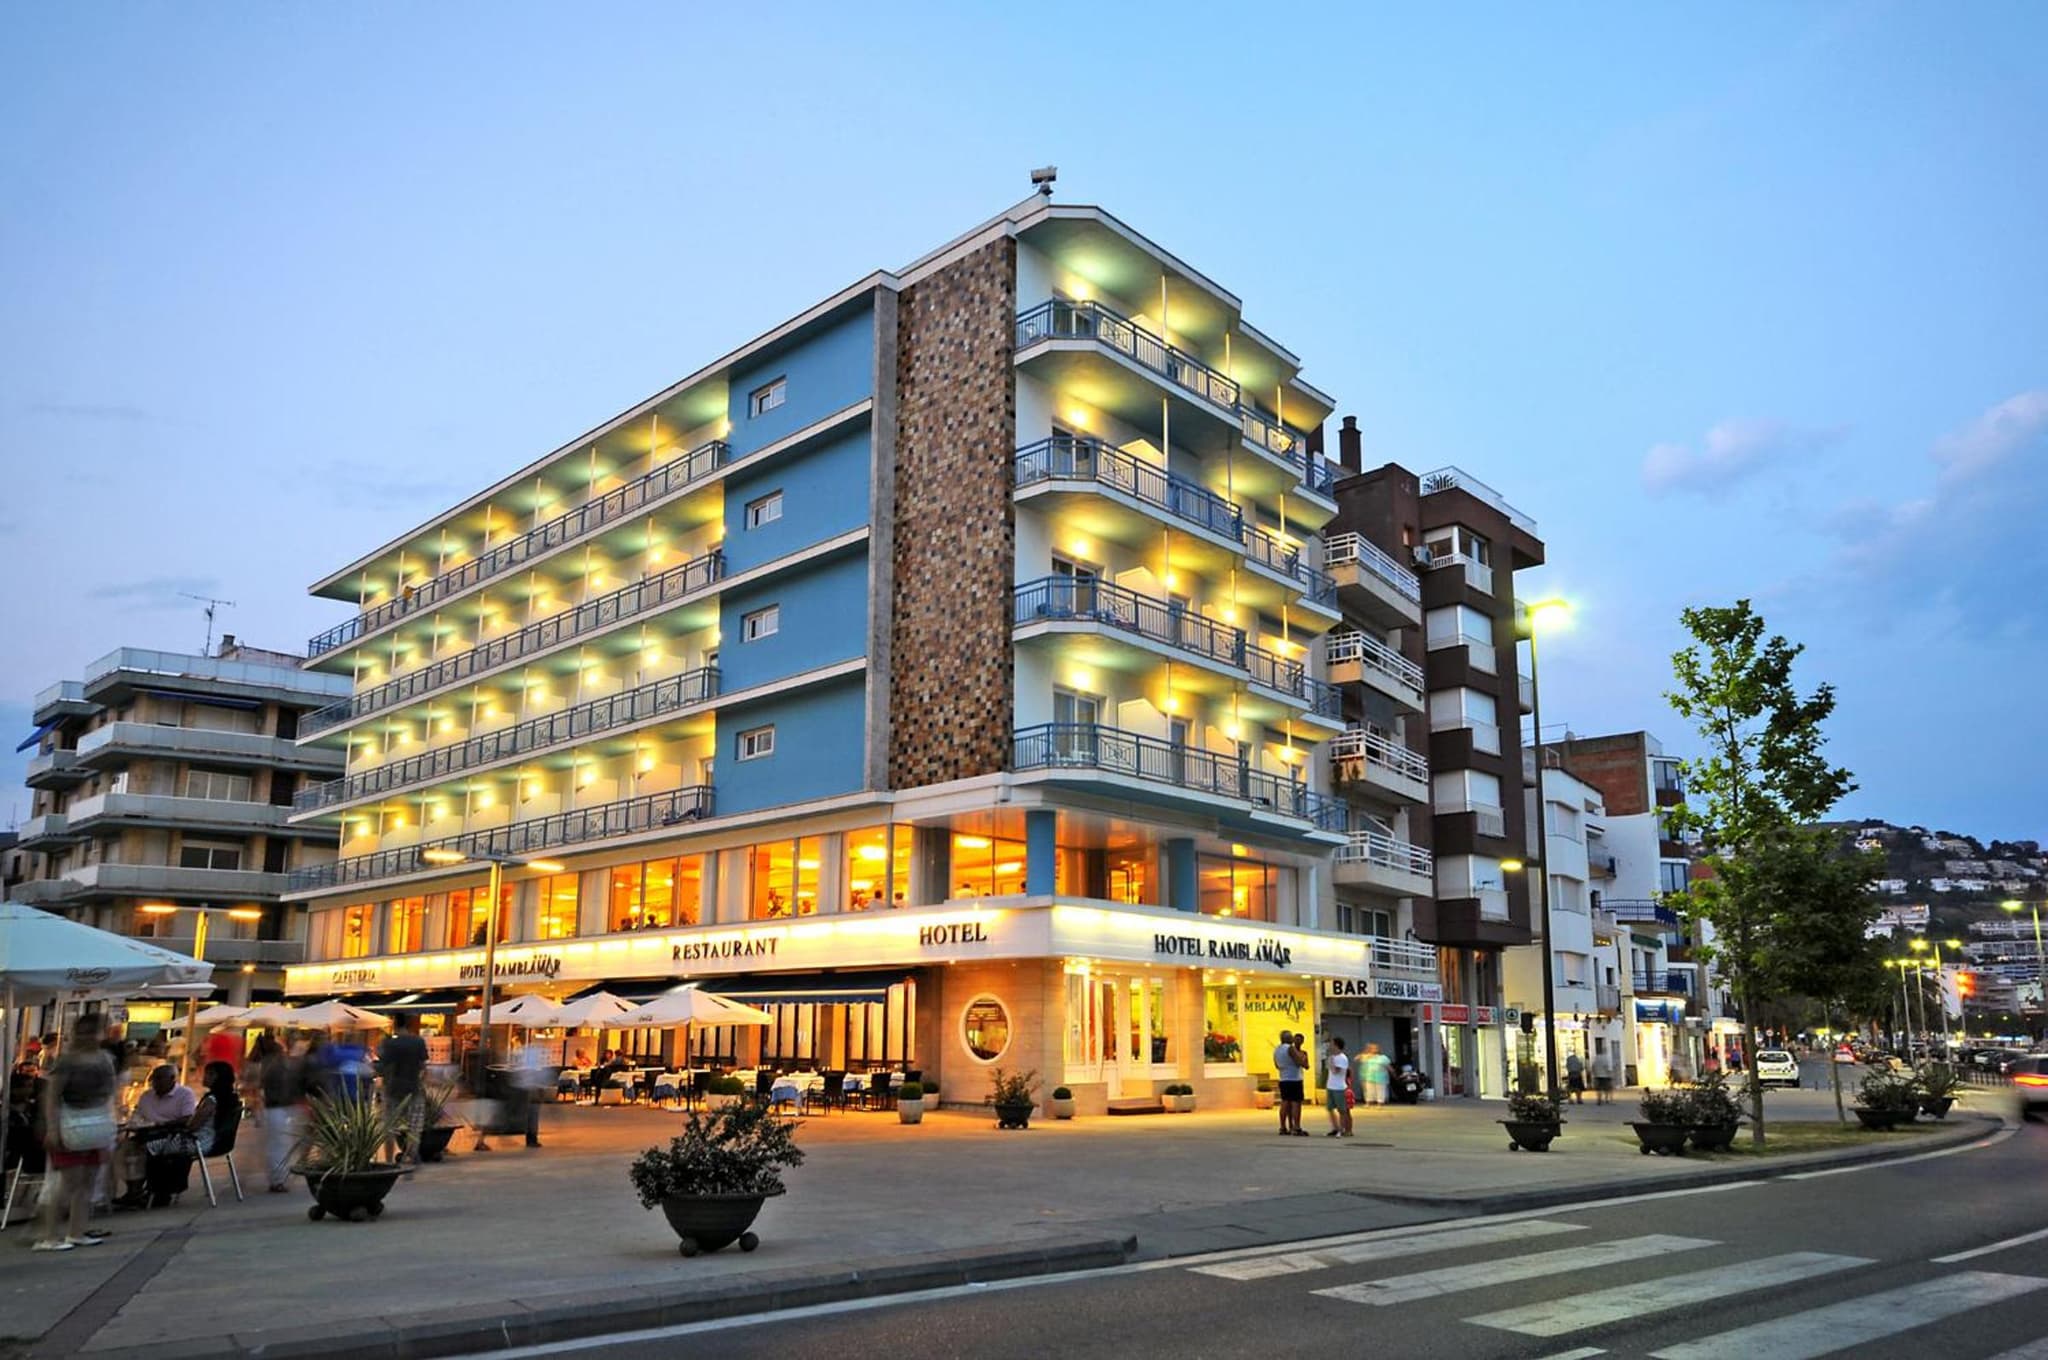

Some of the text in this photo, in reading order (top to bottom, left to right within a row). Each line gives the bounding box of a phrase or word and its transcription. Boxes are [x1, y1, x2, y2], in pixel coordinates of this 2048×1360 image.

[919, 922, 987, 945] HOTEL
[672, 937, 778, 961] RESTAURANT
[1154, 934, 1291, 968] HOTEL RAMBLAMAR
[459, 954, 561, 979] HOTE RAMBLAMAR
[1332, 979, 1368, 996] BAR
